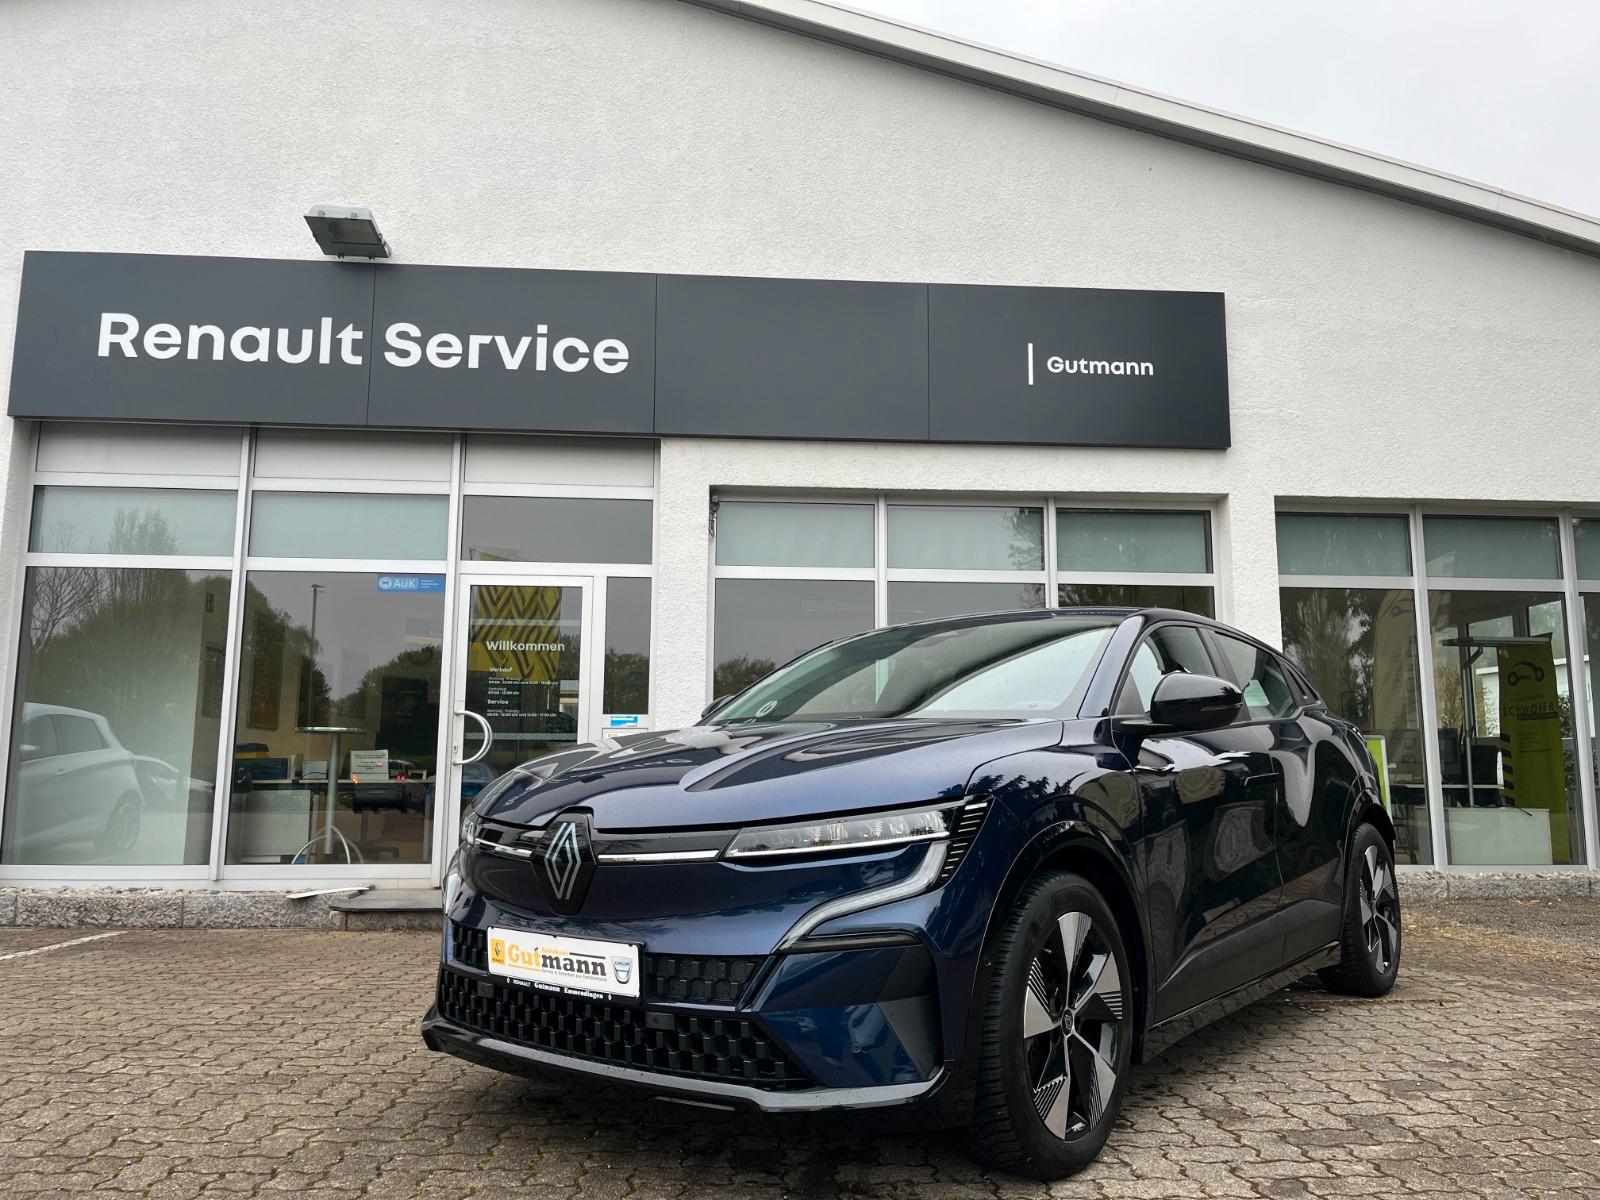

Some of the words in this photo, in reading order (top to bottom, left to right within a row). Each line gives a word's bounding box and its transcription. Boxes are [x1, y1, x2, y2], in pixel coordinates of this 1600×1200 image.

[98, 312, 364, 366] Renault
[384, 322, 630, 374] Service
[1047, 356, 1154, 376] Gutmann
[486, 640, 566, 652] Willkommen
[508, 943, 607, 977] Gutmann
[534, 982, 561, 993] Gutmann
